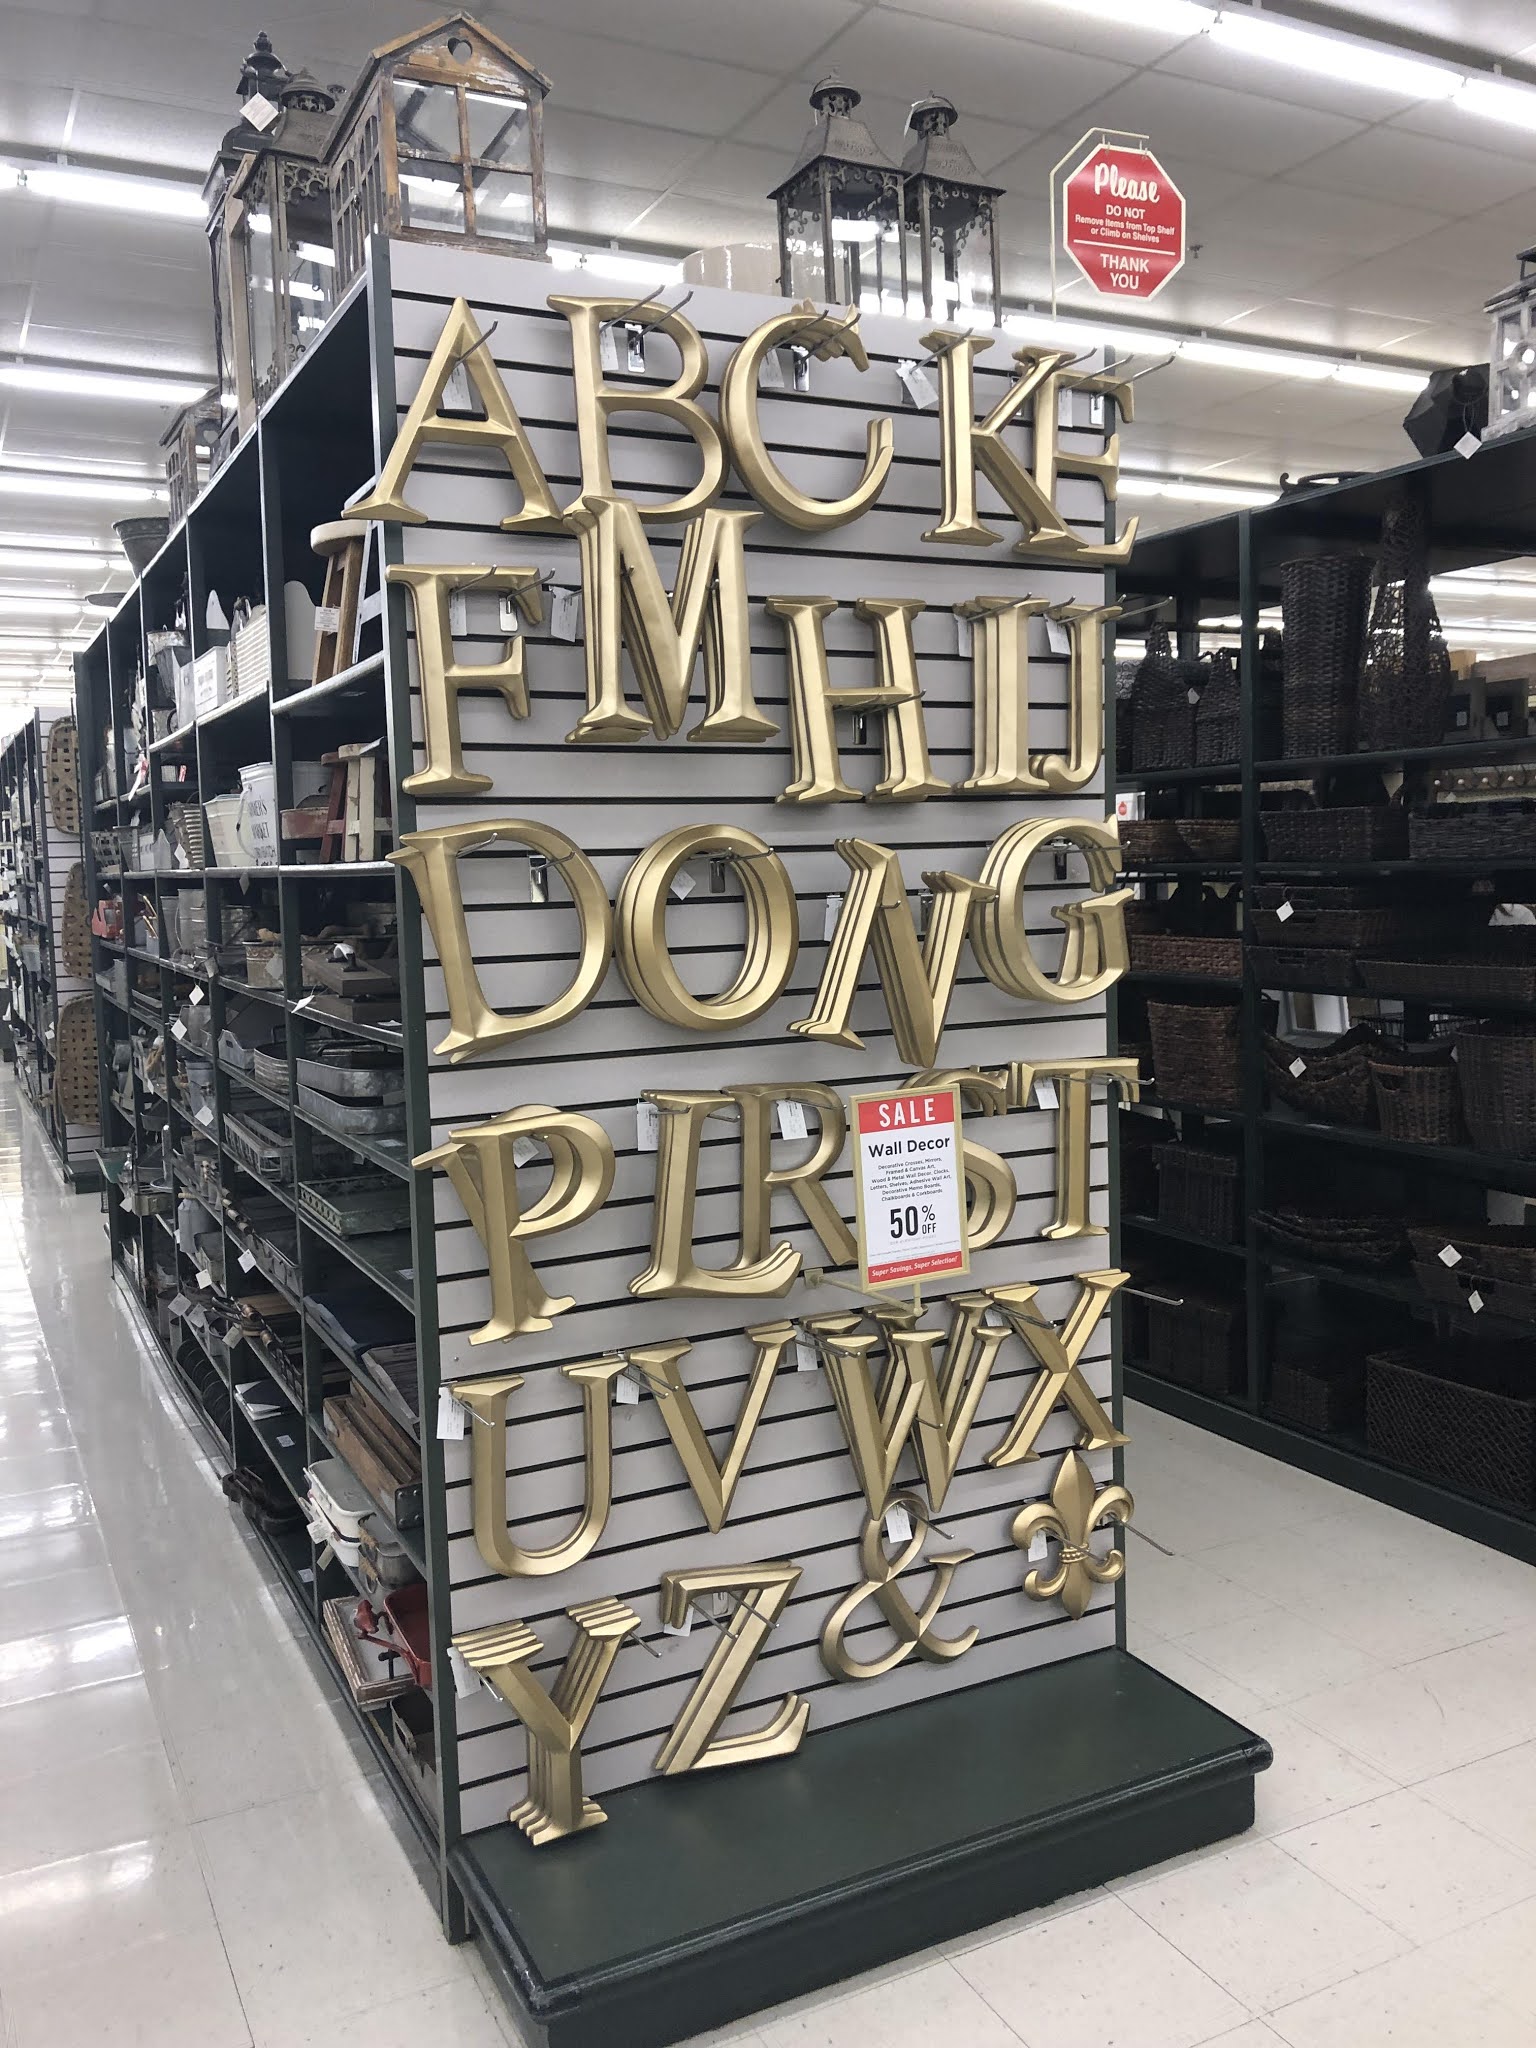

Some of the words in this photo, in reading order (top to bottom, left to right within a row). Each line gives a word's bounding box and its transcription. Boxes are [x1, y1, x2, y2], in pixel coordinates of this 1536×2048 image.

[1094, 162, 1160, 203] Please
[1106, 204, 1121, 216] DO
[1124, 207, 1145, 219] NOT
[1075, 214, 1104, 226] Remove
[1105, 218, 1124, 229] Items
[1126, 221, 1142, 231] from
[1143, 223, 1156, 235] Top
[1157, 225, 1175, 235] Shelf
[1100, 227, 1120, 238] Climb
[1122, 231, 1131, 239] on
[1133, 231, 1160, 243] Shelves
[1100, 253, 1149, 273] THANK
[1110, 272, 1139, 289] YOU
[879, 1098, 936, 1127] SALE
[868, 1141, 902, 1158] Wall
[907, 1137, 950, 1153] Decor
[878, 1162, 904, 1170] Decorative
[882, 1194, 911, 1202] Chalkboards
[916, 1189, 943, 1197] Corkboards
[922, 1222, 937, 1235] OFF
[872, 1267, 889, 1277] Super
[889, 1263, 913, 1274] Savings,
[914, 1260, 931, 1271] Super
[931, 1255, 958, 1267] Selection!
